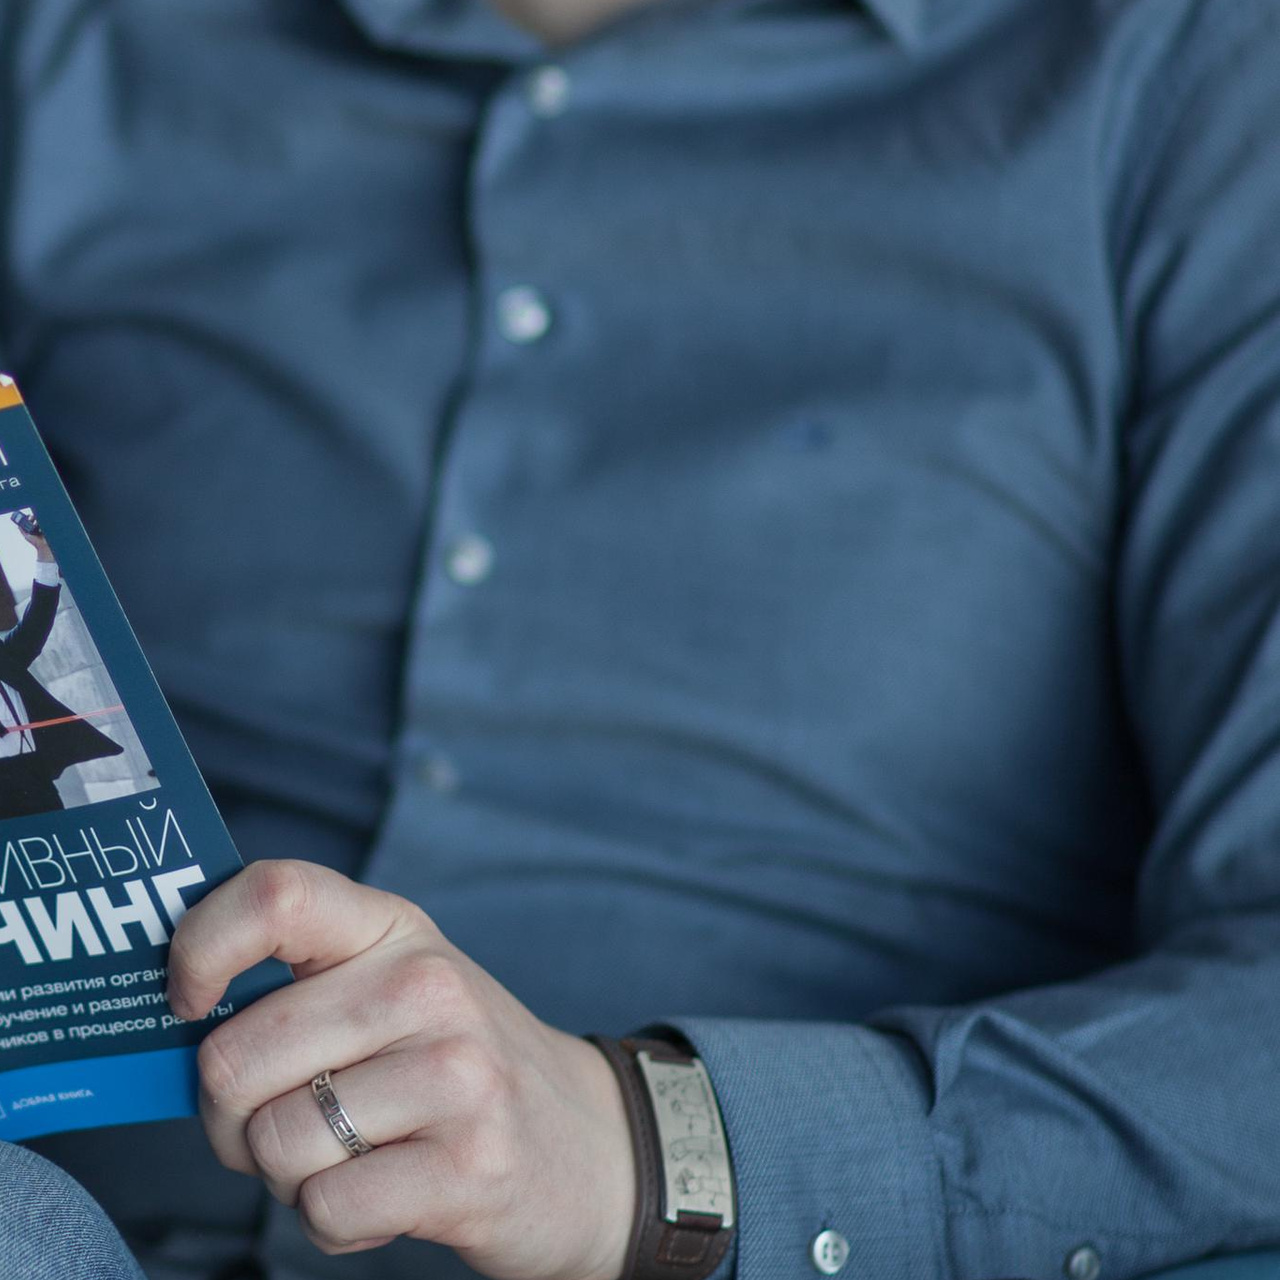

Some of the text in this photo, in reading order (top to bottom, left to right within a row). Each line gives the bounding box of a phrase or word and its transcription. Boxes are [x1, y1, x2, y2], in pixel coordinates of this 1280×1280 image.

[21, 976, 106, 1001] развития
[110, 967, 170, 988] орган
[72, 1003, 84, 1014] и
[88, 992, 168, 1015] развити
[53, 1028, 65, 1040] в
[68, 1016, 156, 1039] процессе
